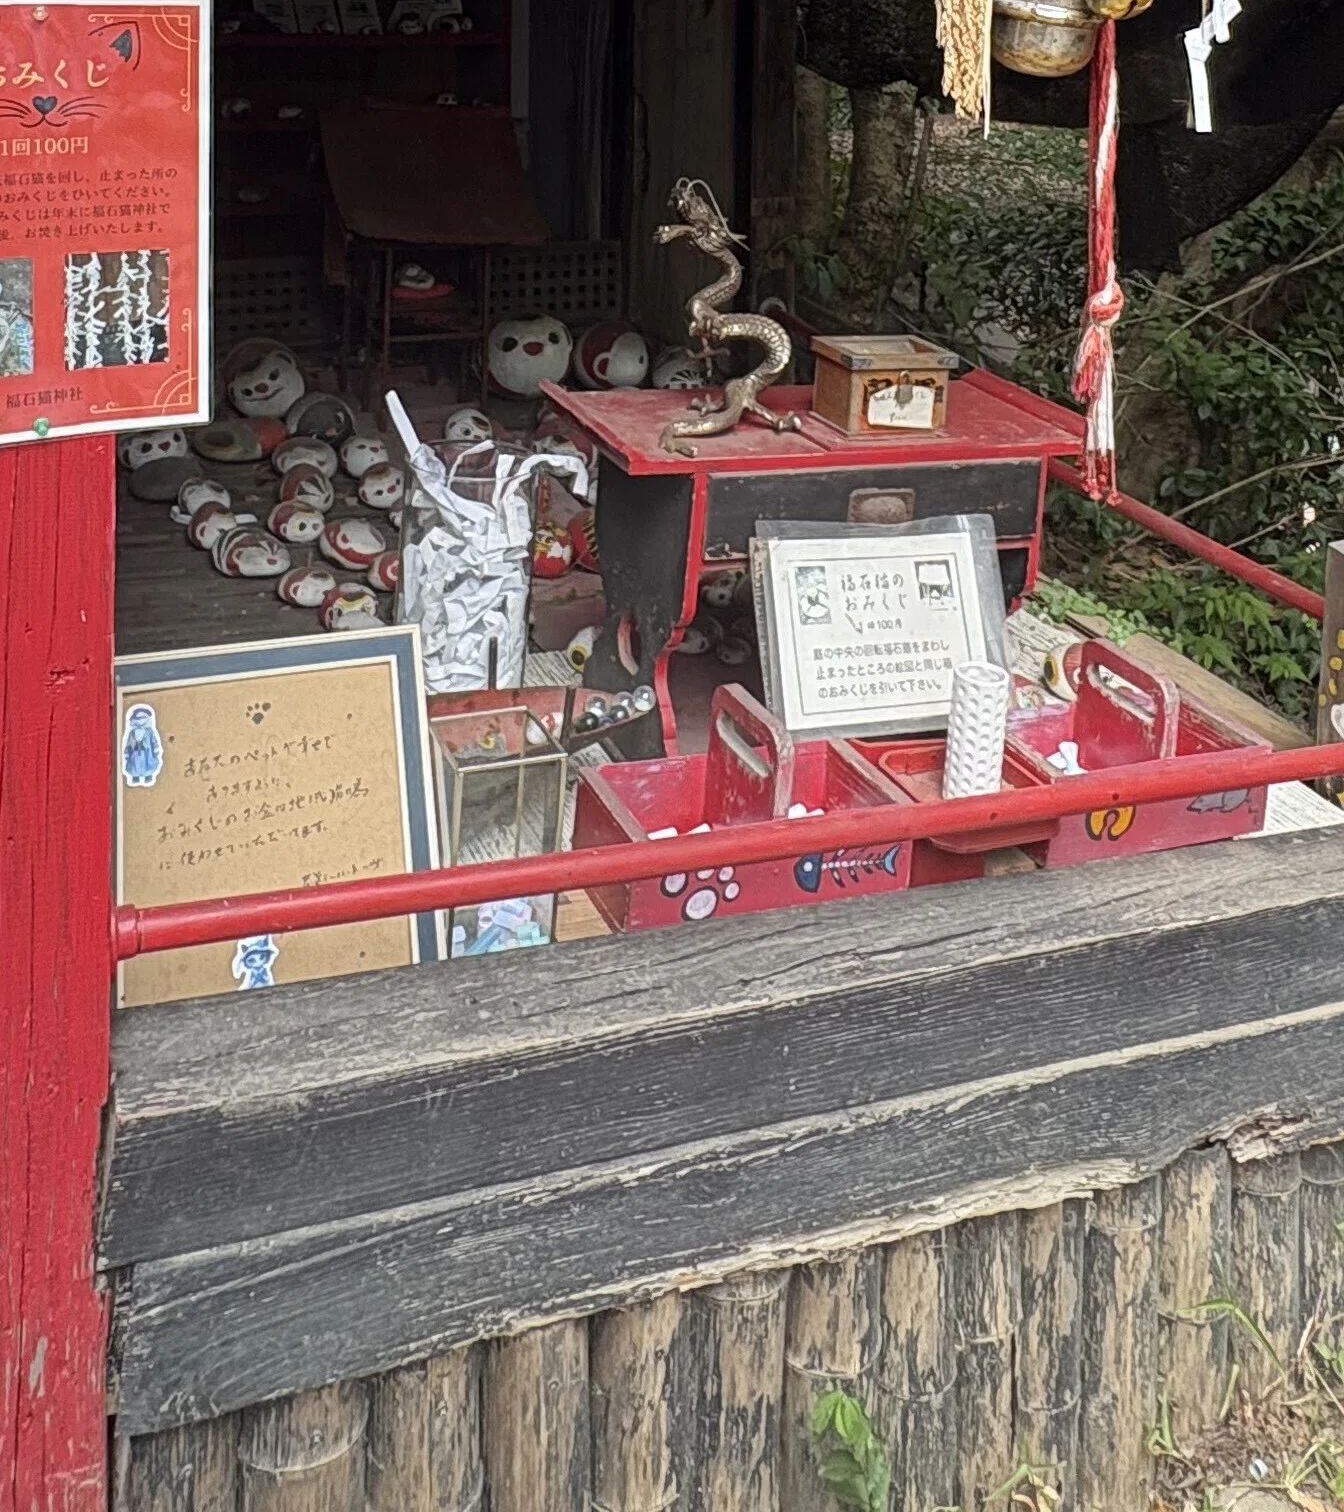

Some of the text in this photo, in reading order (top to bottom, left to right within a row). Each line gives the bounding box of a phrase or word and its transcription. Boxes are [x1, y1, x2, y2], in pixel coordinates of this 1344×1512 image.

[0, 136, 90, 157] 1回100円
[6, 385, 84, 409] 福石猫神社
[845, 593, 908, 611] おみくじ
